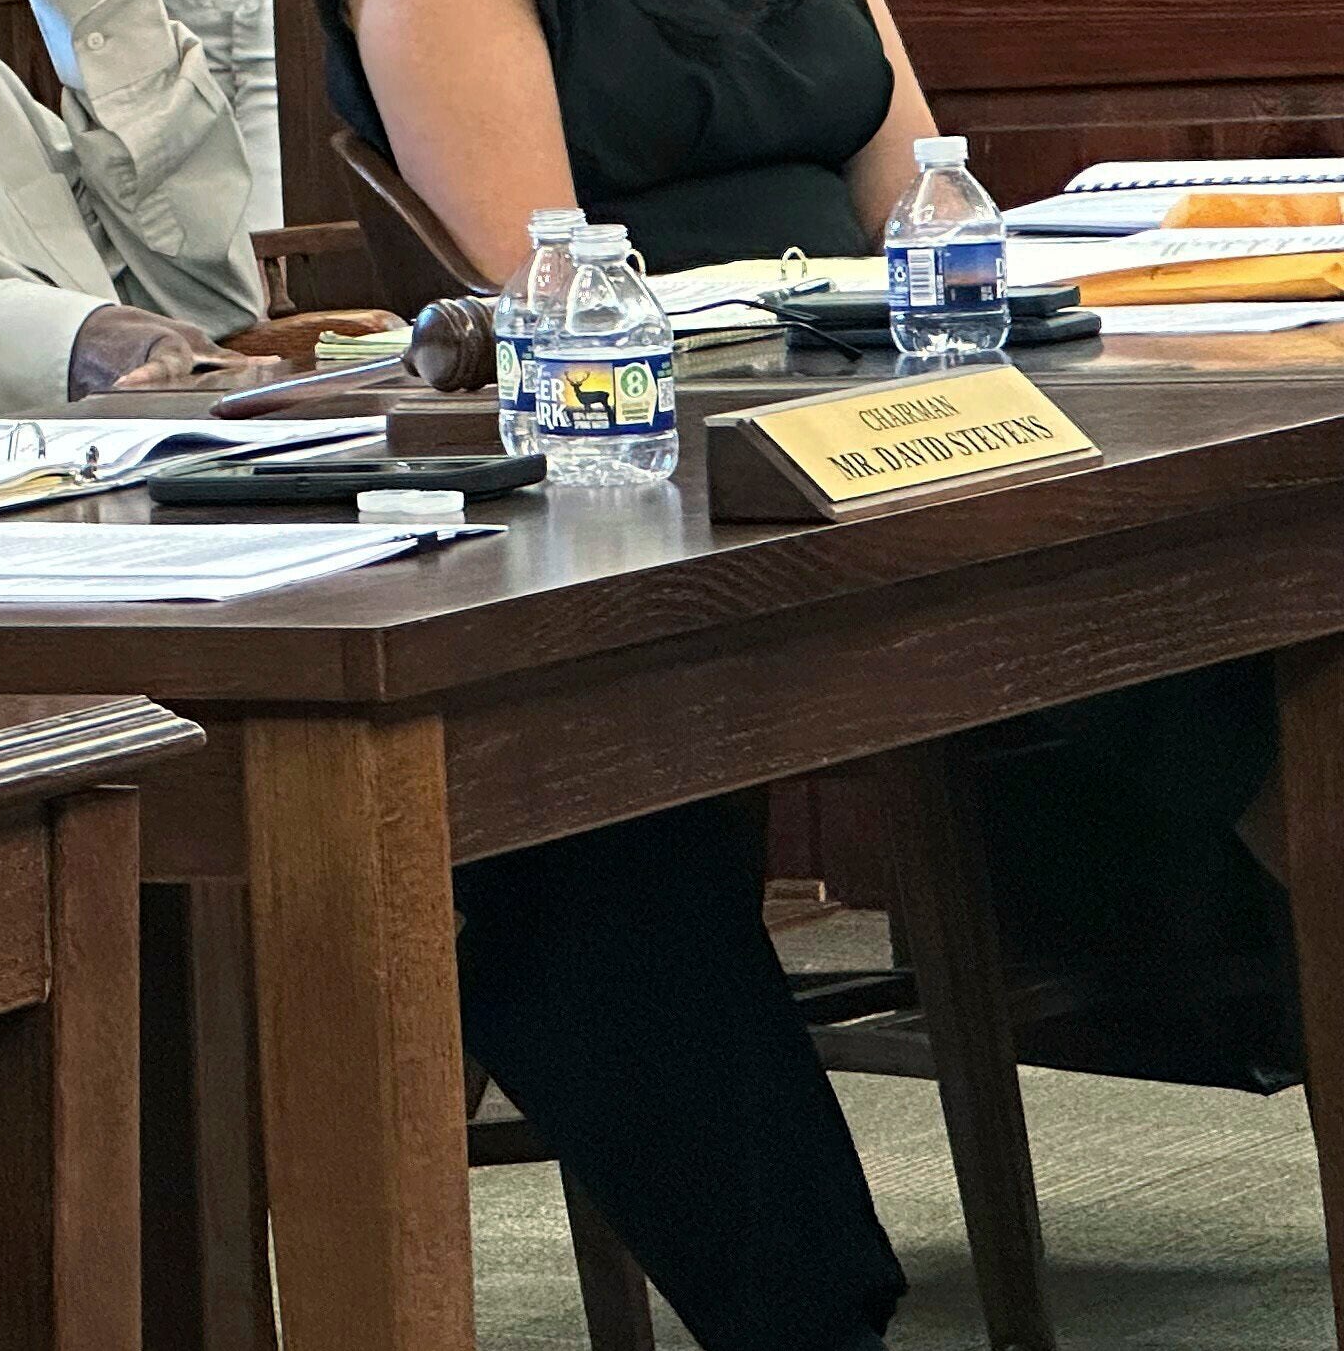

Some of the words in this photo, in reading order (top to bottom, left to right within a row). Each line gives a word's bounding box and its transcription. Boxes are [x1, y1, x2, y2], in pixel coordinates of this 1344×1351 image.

[858, 395, 961, 432] CHAIRMAN
[826, 451, 885, 480] MR.
[872, 436, 953, 470] DAVID
[945, 414, 1054, 456] STEVENS
